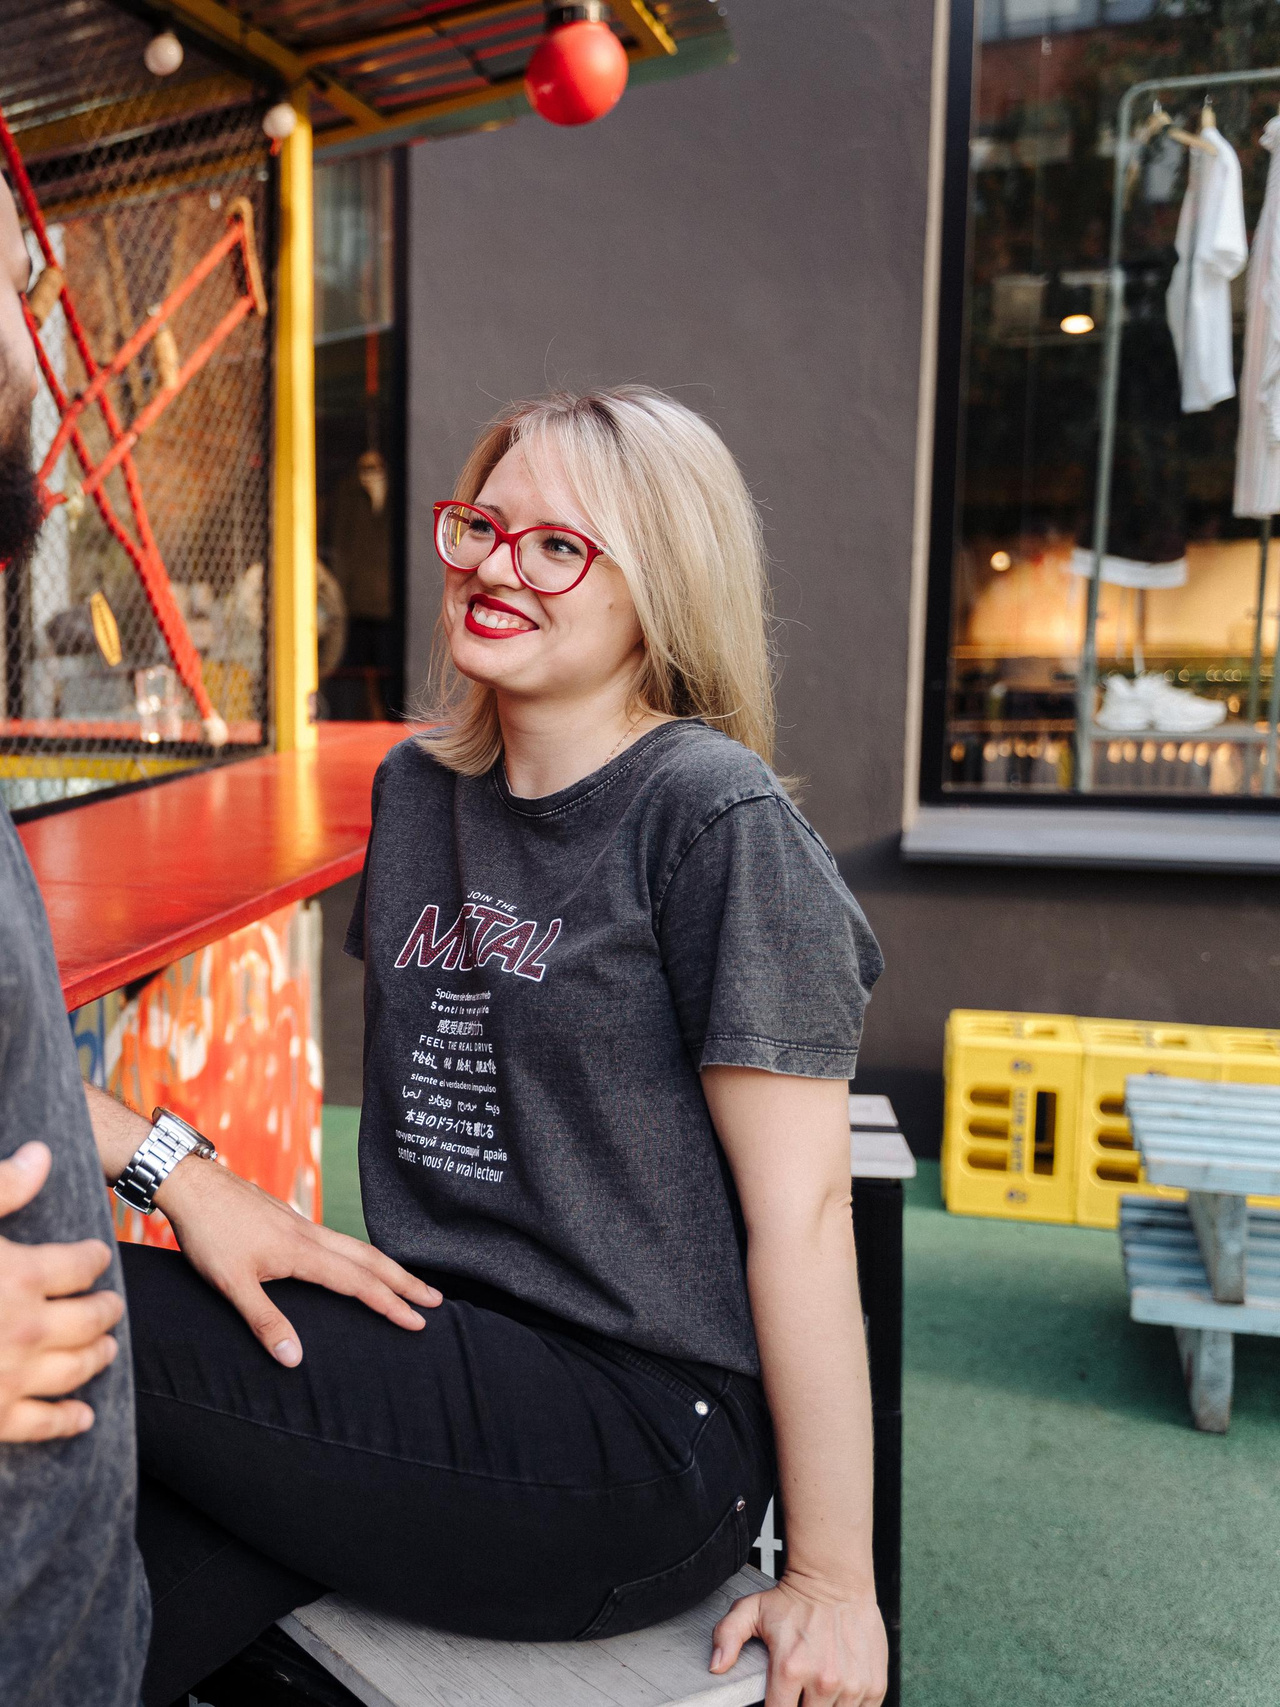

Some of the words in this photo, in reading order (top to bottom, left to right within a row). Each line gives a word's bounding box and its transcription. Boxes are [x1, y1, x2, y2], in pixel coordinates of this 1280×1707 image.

[467, 891, 493, 903] JOIN
[495, 900, 517, 912] THE
[435, 988, 460, 1001] Spüren
[430, 1001, 458, 1014] Senti
[419, 1034, 445, 1049] FEEL
[448, 1041, 458, 1050] THE
[458, 1042, 473, 1052] REAL
[474, 1042, 493, 1053] DRIVE
[410, 1073, 438, 1086] siente
[439, 1079, 446, 1087] el
[446, 1080, 472, 1091] verdadero
[472, 1083, 497, 1094] impulso
[395, 1129, 437, 1148] почувствуй
[440, 1141, 480, 1158] настоящий
[483, 1148, 507, 1162] драйв
[398, 1147, 417, 1164] sentez
[422, 1154, 443, 1169] vous
[443, 1156, 455, 1172] le
[455, 1161, 474, 1177] vrai
[473, 1162, 504, 1183] lecteur
